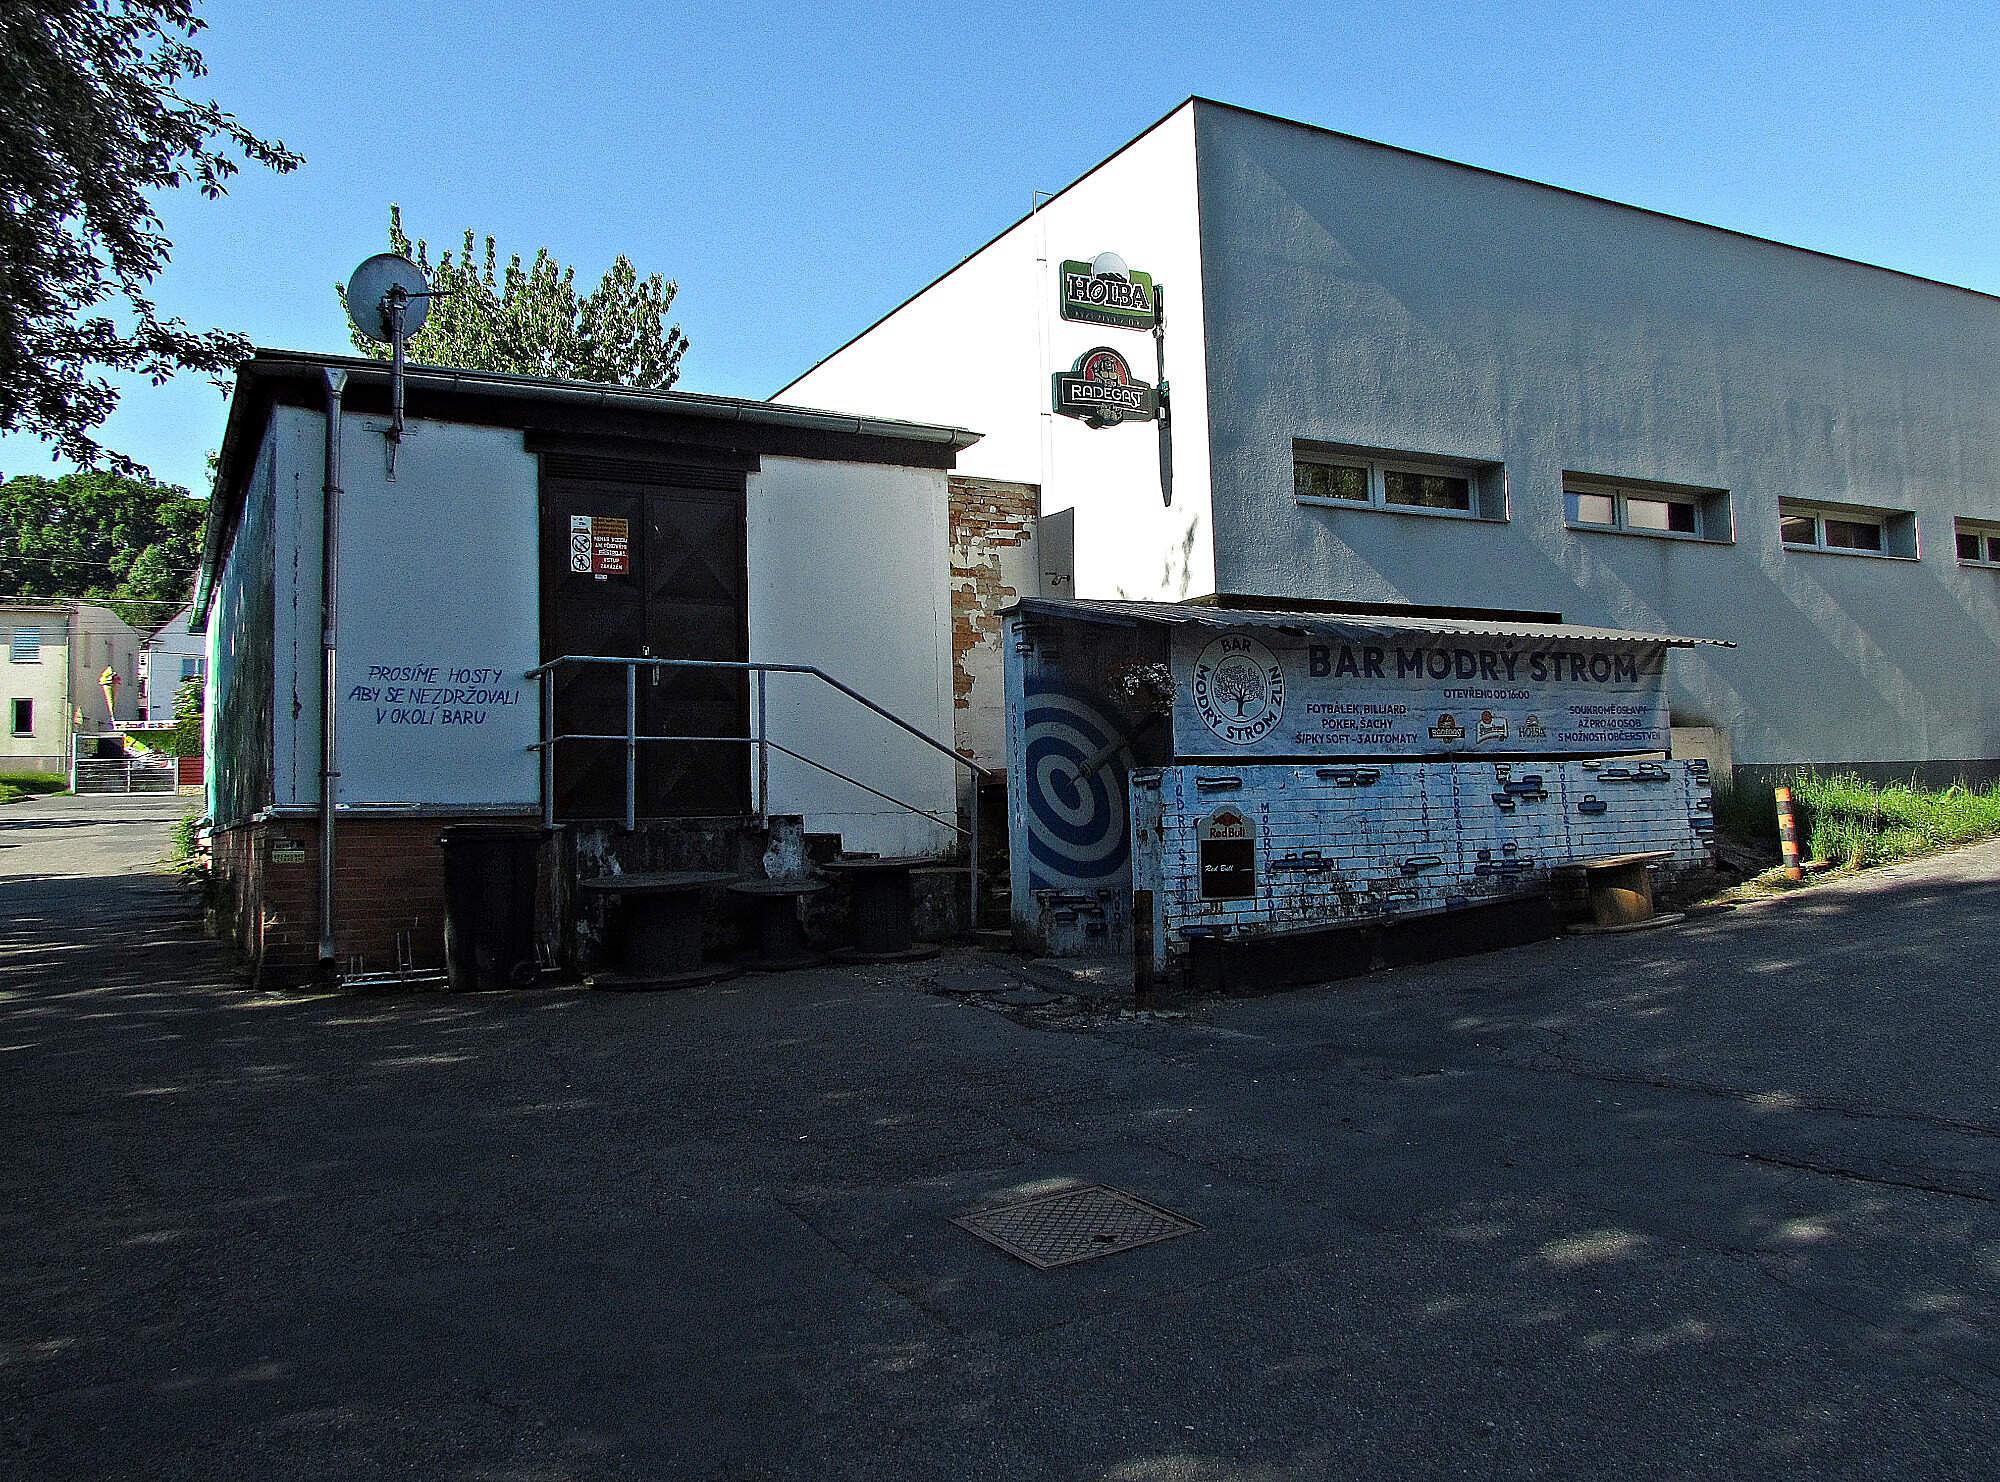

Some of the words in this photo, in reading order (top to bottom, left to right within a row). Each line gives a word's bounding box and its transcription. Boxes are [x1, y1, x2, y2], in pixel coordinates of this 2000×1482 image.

[1068, 276, 1150, 309] HOLBA
[1072, 384, 1143, 407] RADEGAST
[1221, 638, 1251, 653] BAR
[1309, 644, 1385, 679] BAR
[1396, 642, 1519, 681] MODRÝ
[1529, 651, 1638, 683] STROM
[368, 664, 439, 684] PROSÍME
[449, 668, 502, 684] HOSTY
[349, 686, 380, 701] ABY
[385, 687, 405, 704] SE
[409, 686, 519, 705] NEZDRŽOVALI
[1444, 687, 1493, 699] OTEVŘENO
[1494, 690, 1507, 699] OD
[1508, 689, 1530, 699] 16:00
[1196, 664, 1222, 728] MODRÝ
[1226, 710, 1278, 740] STROM
[1267, 666, 1282, 707] ZLÍN
[1306, 701, 1362, 715] FOTBÁLEK,
[1363, 704, 1406, 714] BILLIARD
[376, 708, 387, 725] V
[391, 706, 440, 725] OKOLÍ
[442, 709, 487, 725] BARU
[1569, 704, 1616, 715] SOUKROMÉ
[1322, 719, 1358, 730] POKER,
[1359, 717, 1394, 729] ŠACHY
[1578, 716, 1590, 728] AŽ
[1590, 719, 1606, 728] PRO
[1617, 719, 1641, 728] OSOB
[1295, 732, 1324, 744] ŠIPKY
[1326, 734, 1350, 744] SOFT
[1364, 733, 1418, 744] AUTOMATY
[1558, 733, 1564, 741] S
[1565, 730, 1606, 741] MOŽNOSTÍ
[1210, 827, 1228, 838] Red
[1229, 827, 1246, 838] Bull
[1204, 864, 1219, 873] Red
